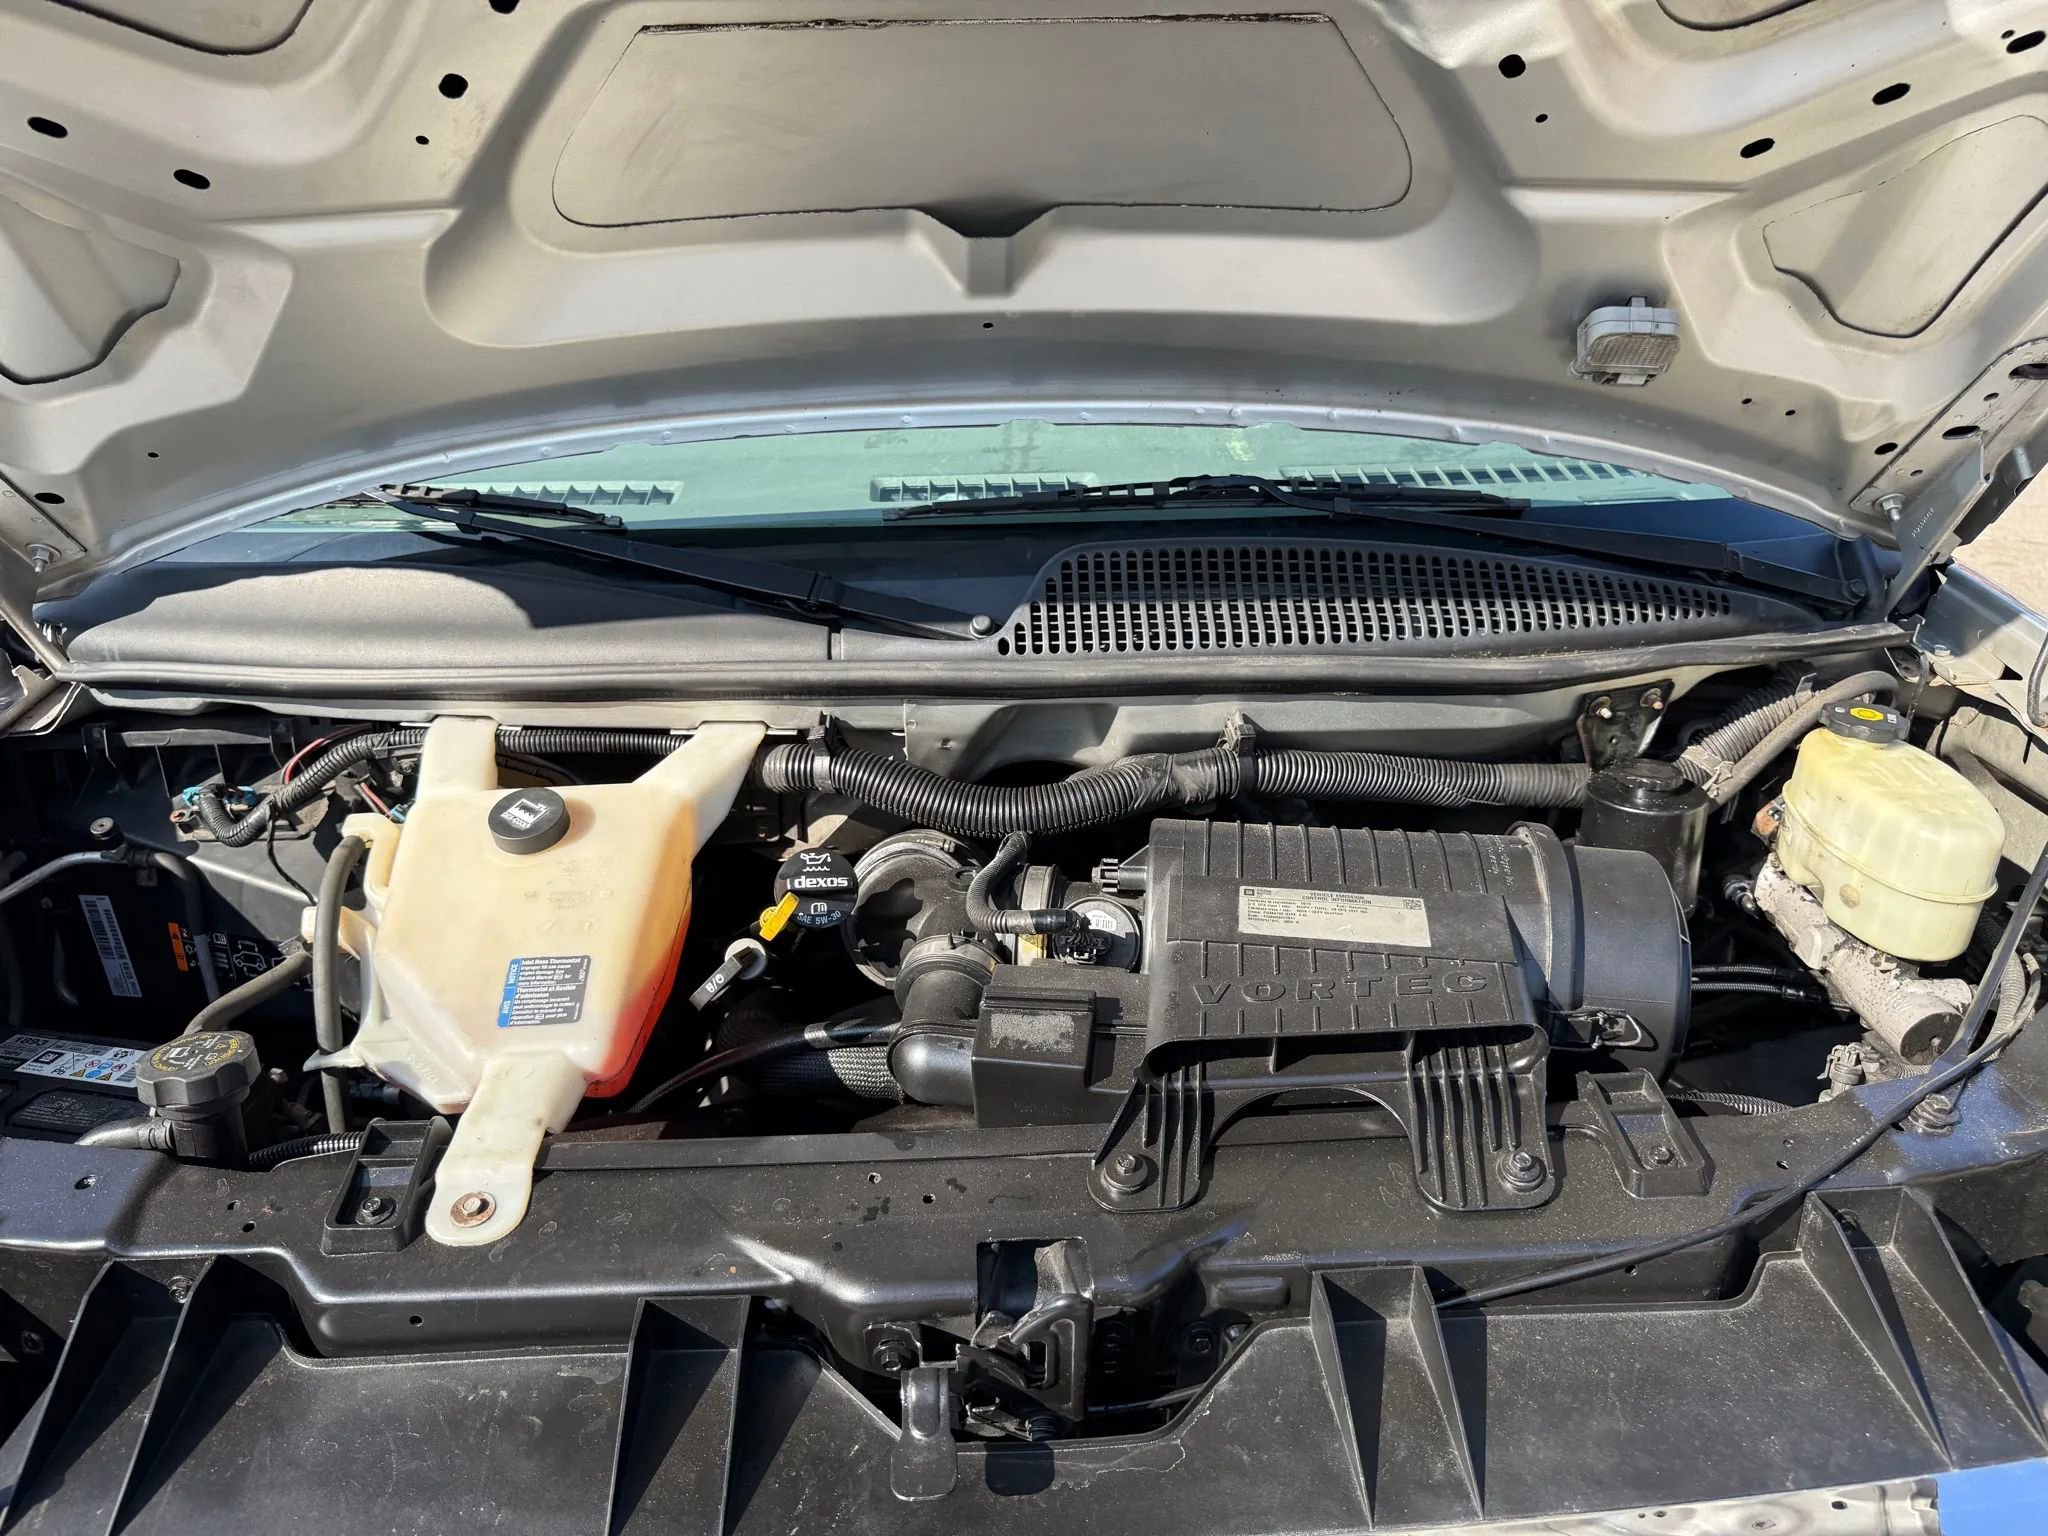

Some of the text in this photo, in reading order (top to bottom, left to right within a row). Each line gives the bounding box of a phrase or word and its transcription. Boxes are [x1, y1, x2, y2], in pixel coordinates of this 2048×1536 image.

[794, 875, 849, 888] dexos
[1331, 897, 1372, 905] INFORMATION
[797, 910, 842, 925] SAE 5W-30
[507, 963, 519, 984] NOTICE
[1192, 971, 1488, 1006] VORTEC
[501, 1000, 511, 1014] AVIS
